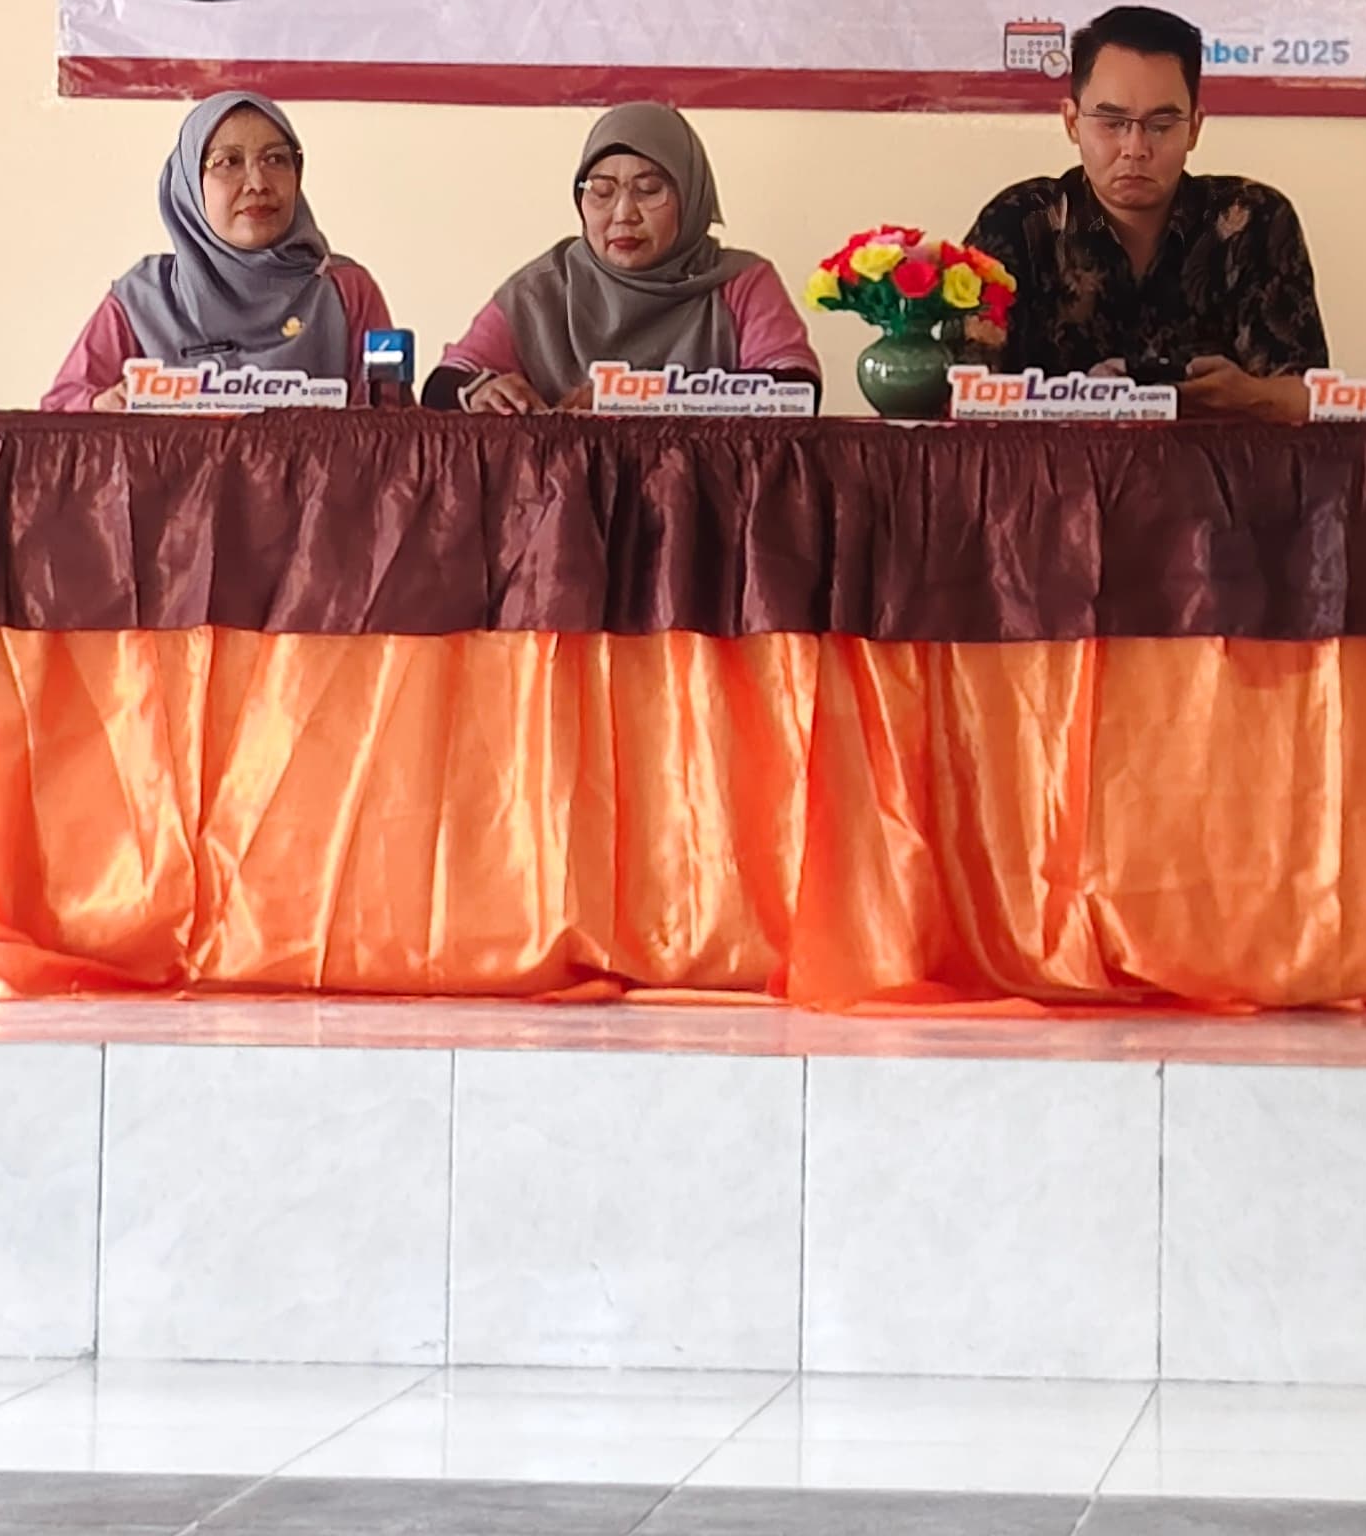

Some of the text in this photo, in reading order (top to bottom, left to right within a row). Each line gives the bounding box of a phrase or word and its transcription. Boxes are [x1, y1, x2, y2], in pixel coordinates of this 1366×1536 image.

[1271, 39, 1351, 65] 2025
[130, 366, 343, 400] TopLoker.com
[595, 366, 811, 401] TopLoker.com
[953, 372, 1171, 407] TopLoker.com
